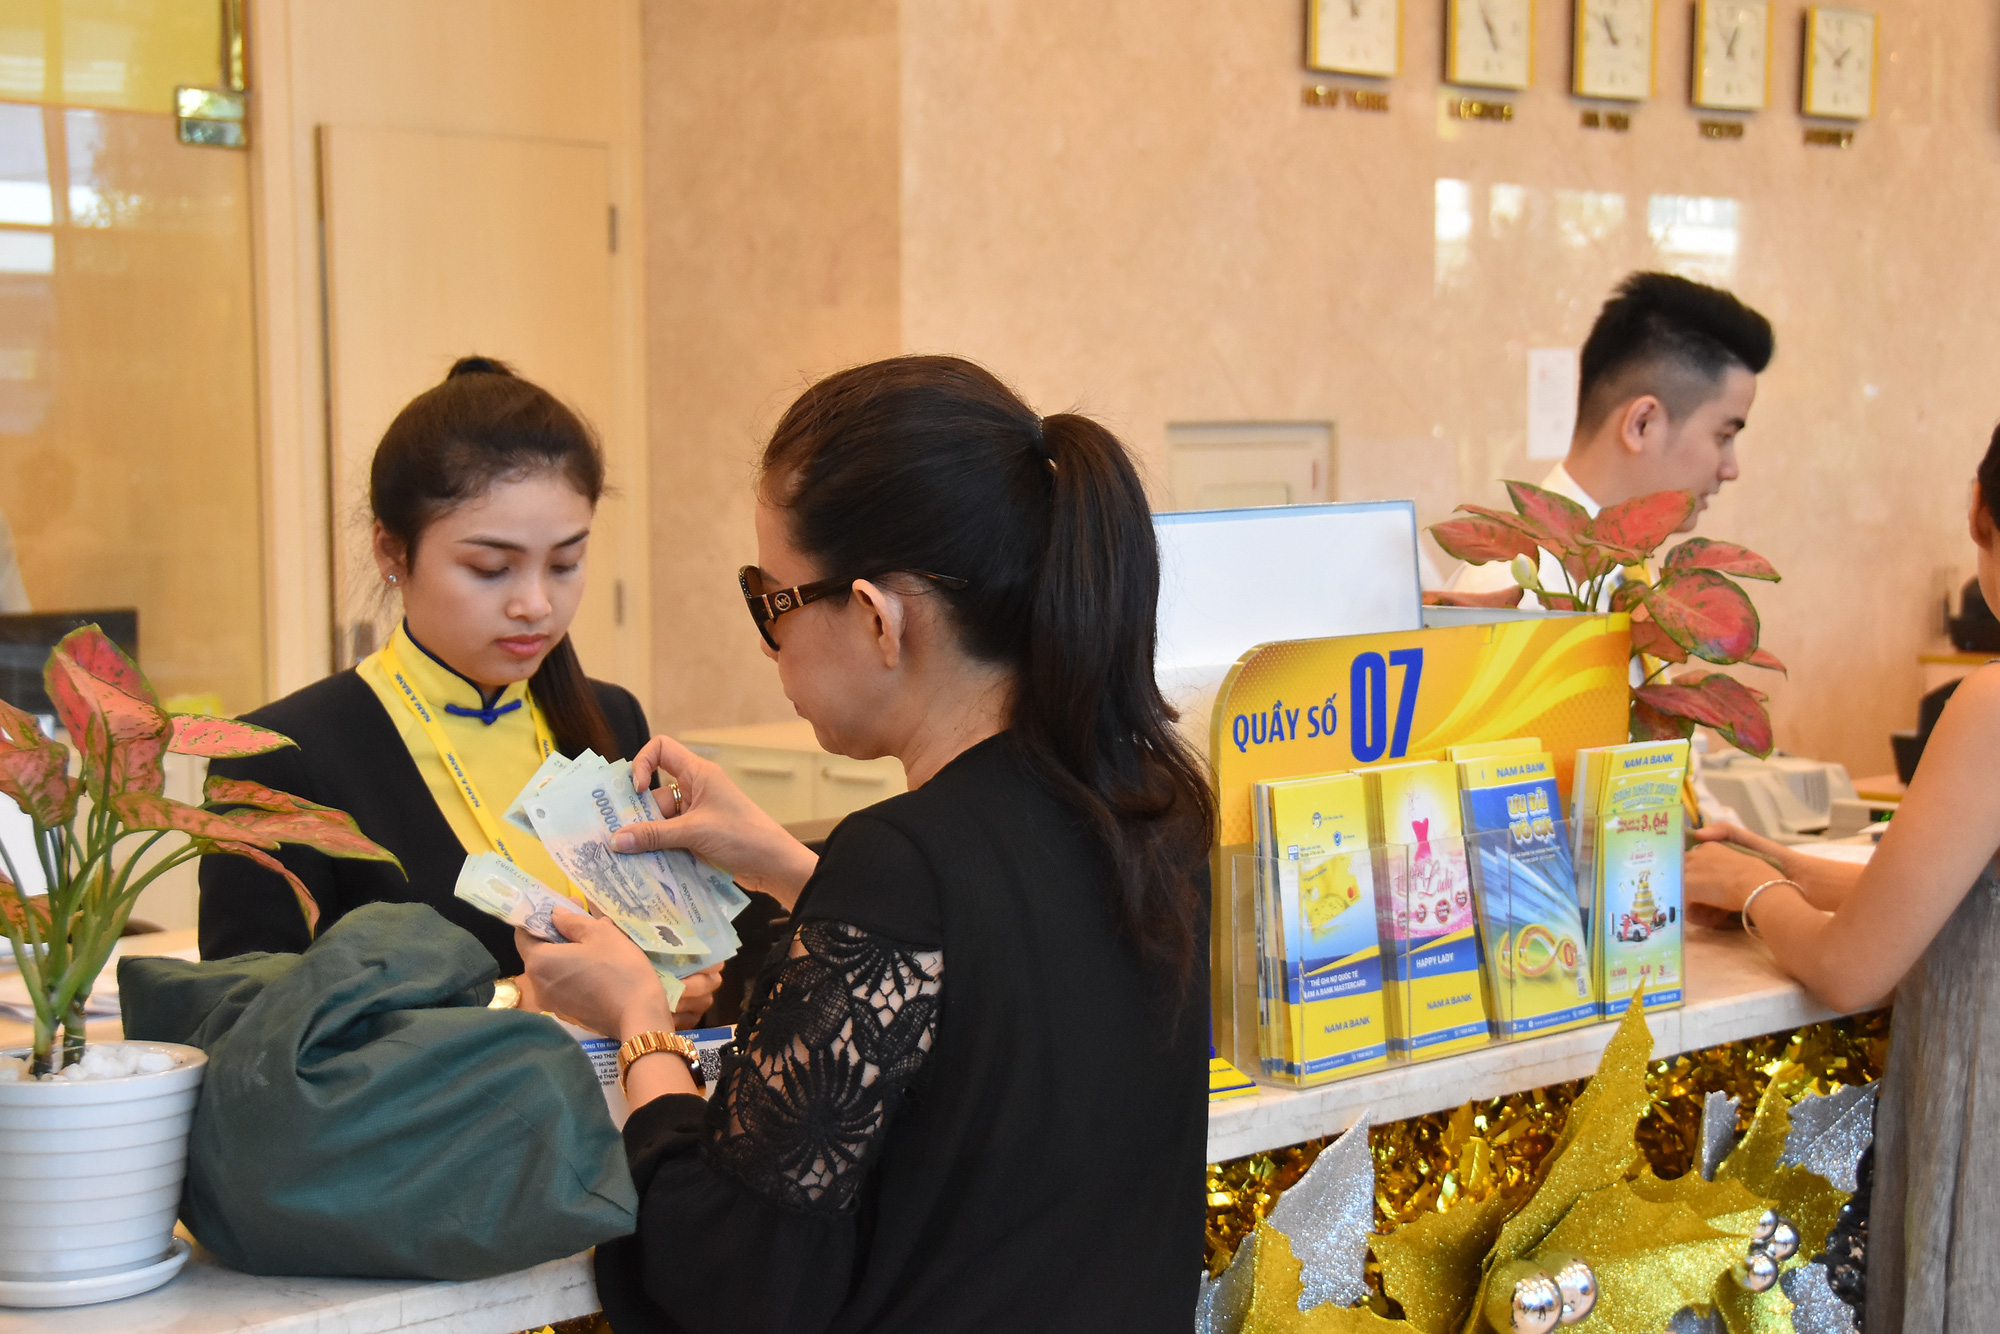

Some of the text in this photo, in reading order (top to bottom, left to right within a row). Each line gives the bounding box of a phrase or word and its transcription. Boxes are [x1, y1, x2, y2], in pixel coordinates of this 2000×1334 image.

[394, 672, 413, 696] BANK
[415, 701, 431, 722] NAM
[1233, 647, 1424, 763] QUẦY SỐ 07
[447, 752, 464, 778] BANK
[1623, 753, 1674, 768] NAM A BANK
[1496, 762, 1546, 778] NAM A BANK
[465, 785, 480, 808] NAM
[1641, 811, 1668, 832] 3,64
[1416, 952, 1454, 968] HAPPY LADY
[1320, 976, 1330, 985] GHI
[1337, 972, 1351, 982] QUỐC
[1320, 986, 1334, 995] BANK
[1333, 979, 1367, 992] MASTERCARD
[1427, 993, 1473, 1010] NAM A BANK
[1324, 1016, 1371, 1034] NAM A BANK
